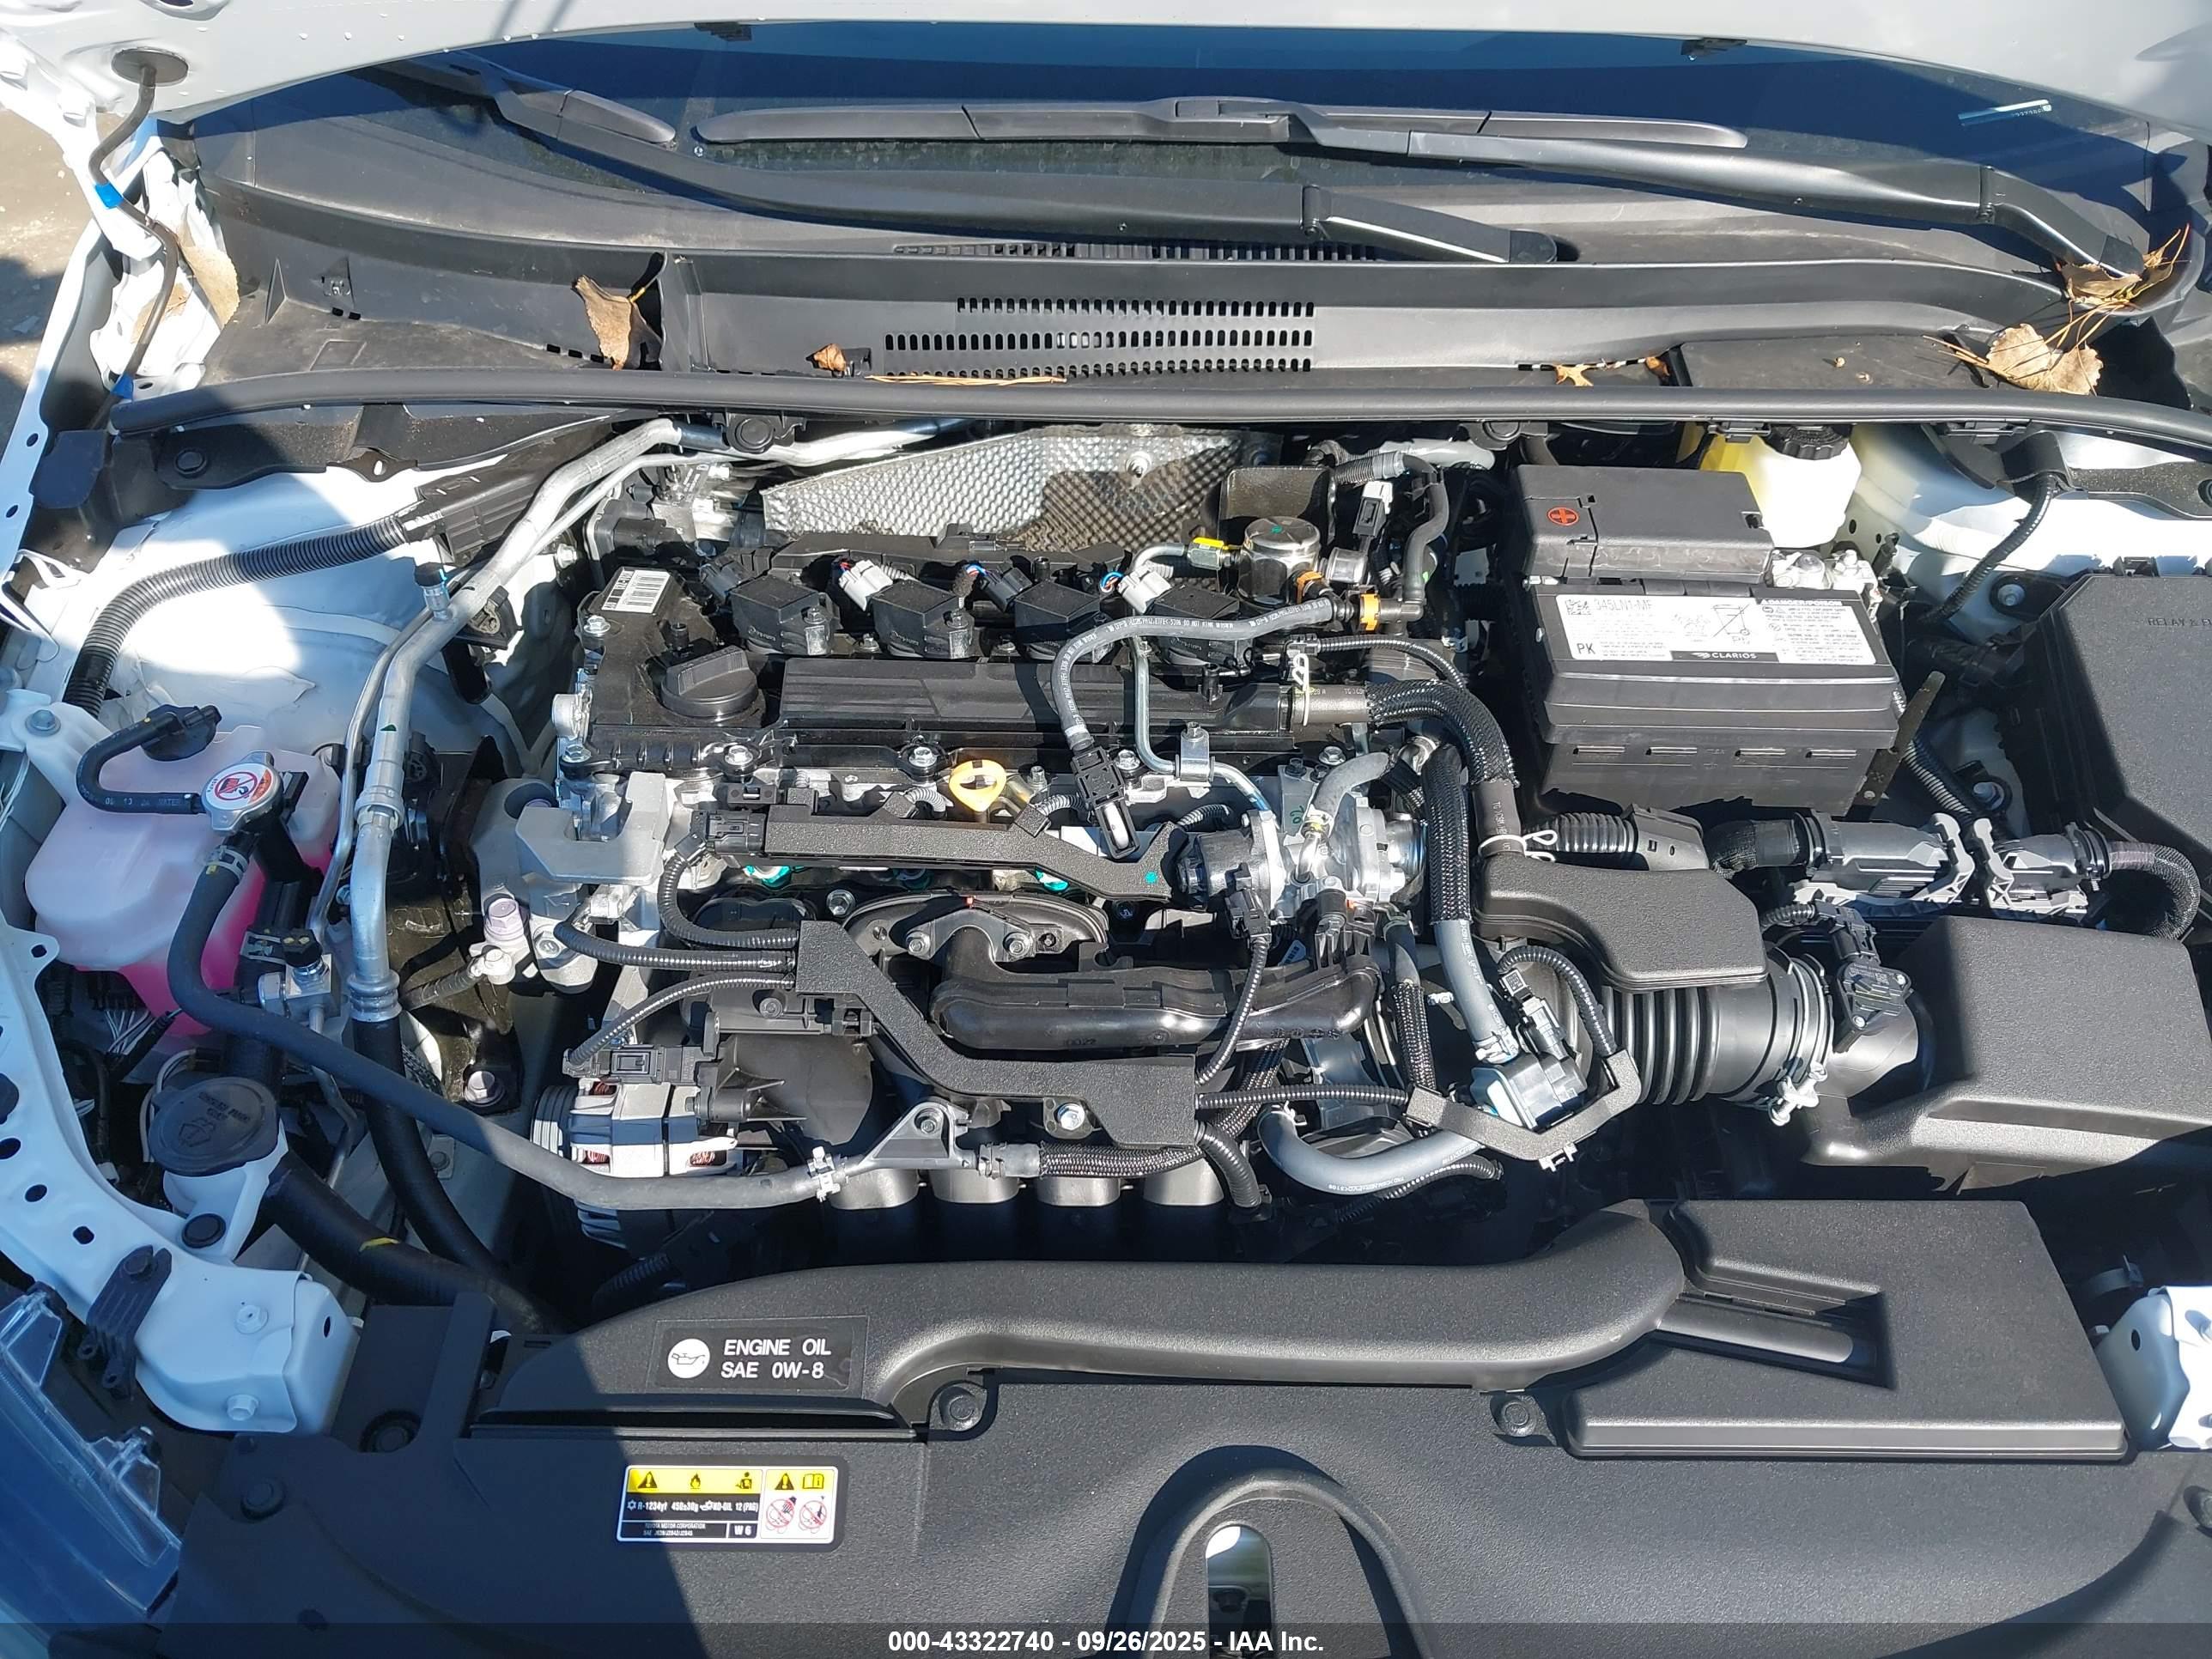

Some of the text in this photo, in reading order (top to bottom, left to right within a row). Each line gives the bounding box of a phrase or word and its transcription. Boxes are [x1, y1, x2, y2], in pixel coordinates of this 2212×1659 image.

[1577, 643, 1596, 655] PK
[1711, 652, 1758, 660] CLARIOS
[723, 1338, 832, 1356] ENGINE OIL
[720, 1361, 824, 1379] SAE 0W-8
